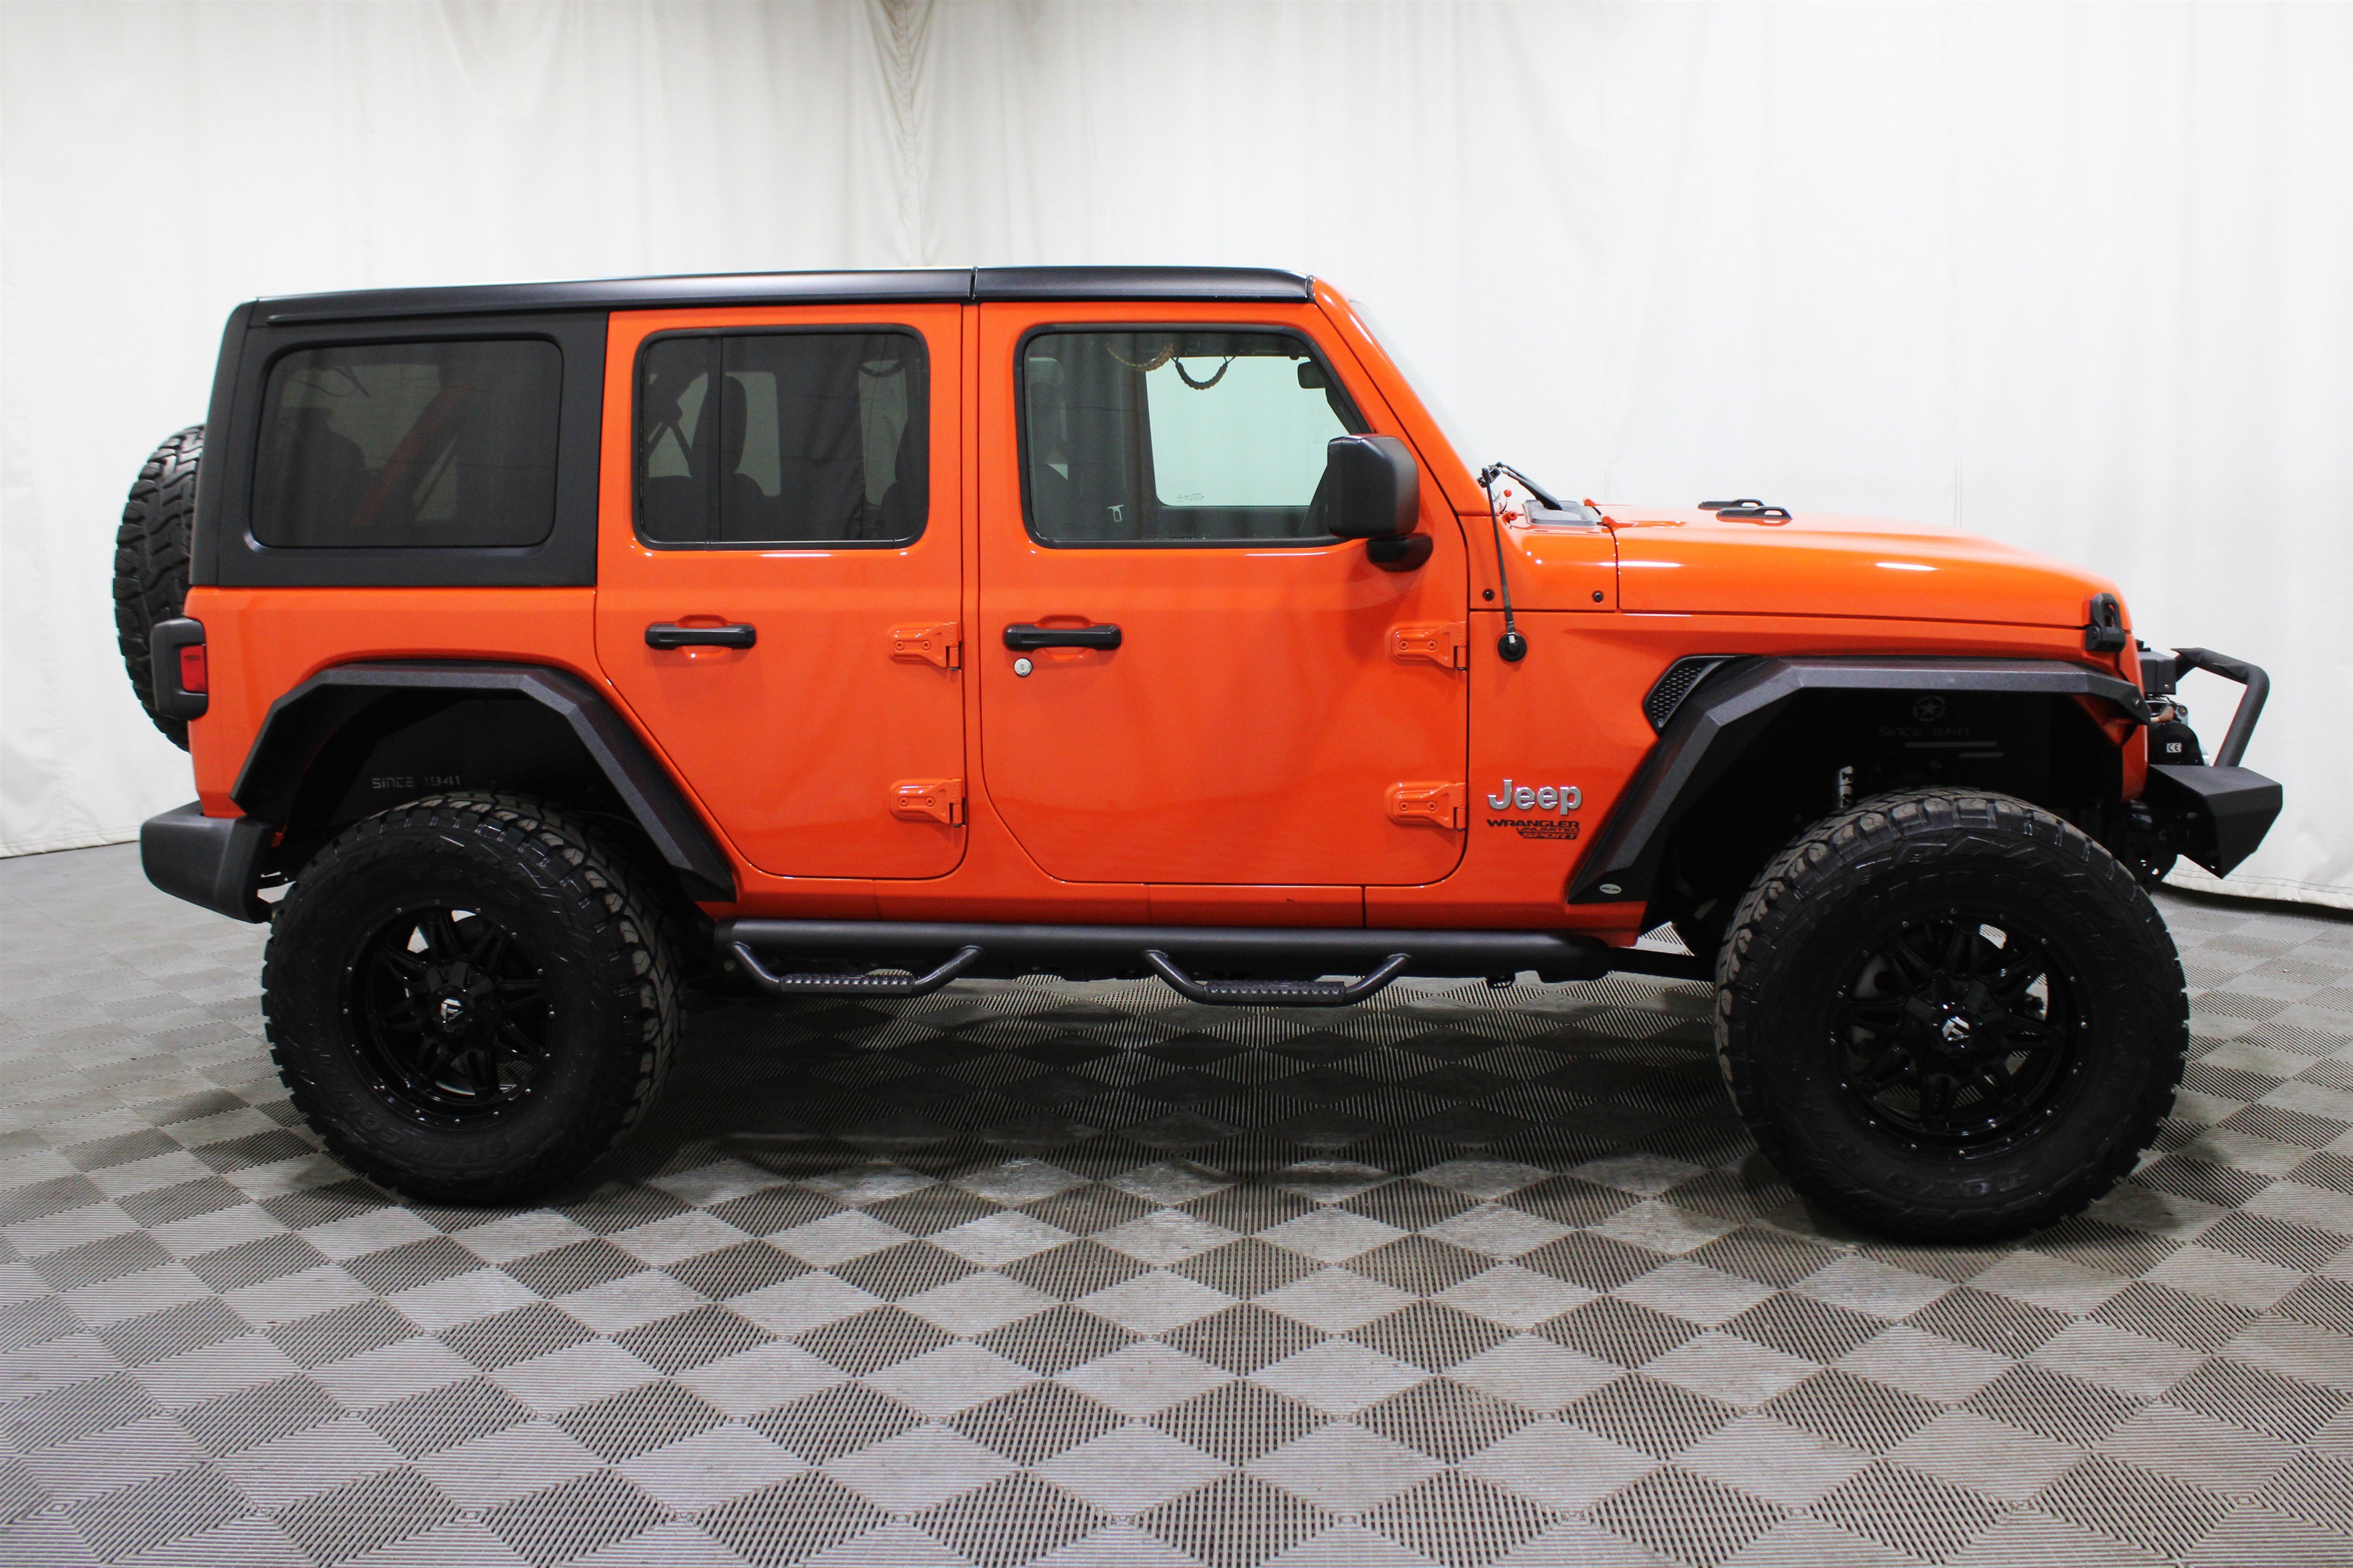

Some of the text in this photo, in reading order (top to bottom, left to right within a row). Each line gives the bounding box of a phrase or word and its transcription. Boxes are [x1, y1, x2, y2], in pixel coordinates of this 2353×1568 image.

[424, 775, 461, 786] 1941
[1487, 779, 1583, 816] Jeep
[1486, 818, 1580, 828] WRANGLER
